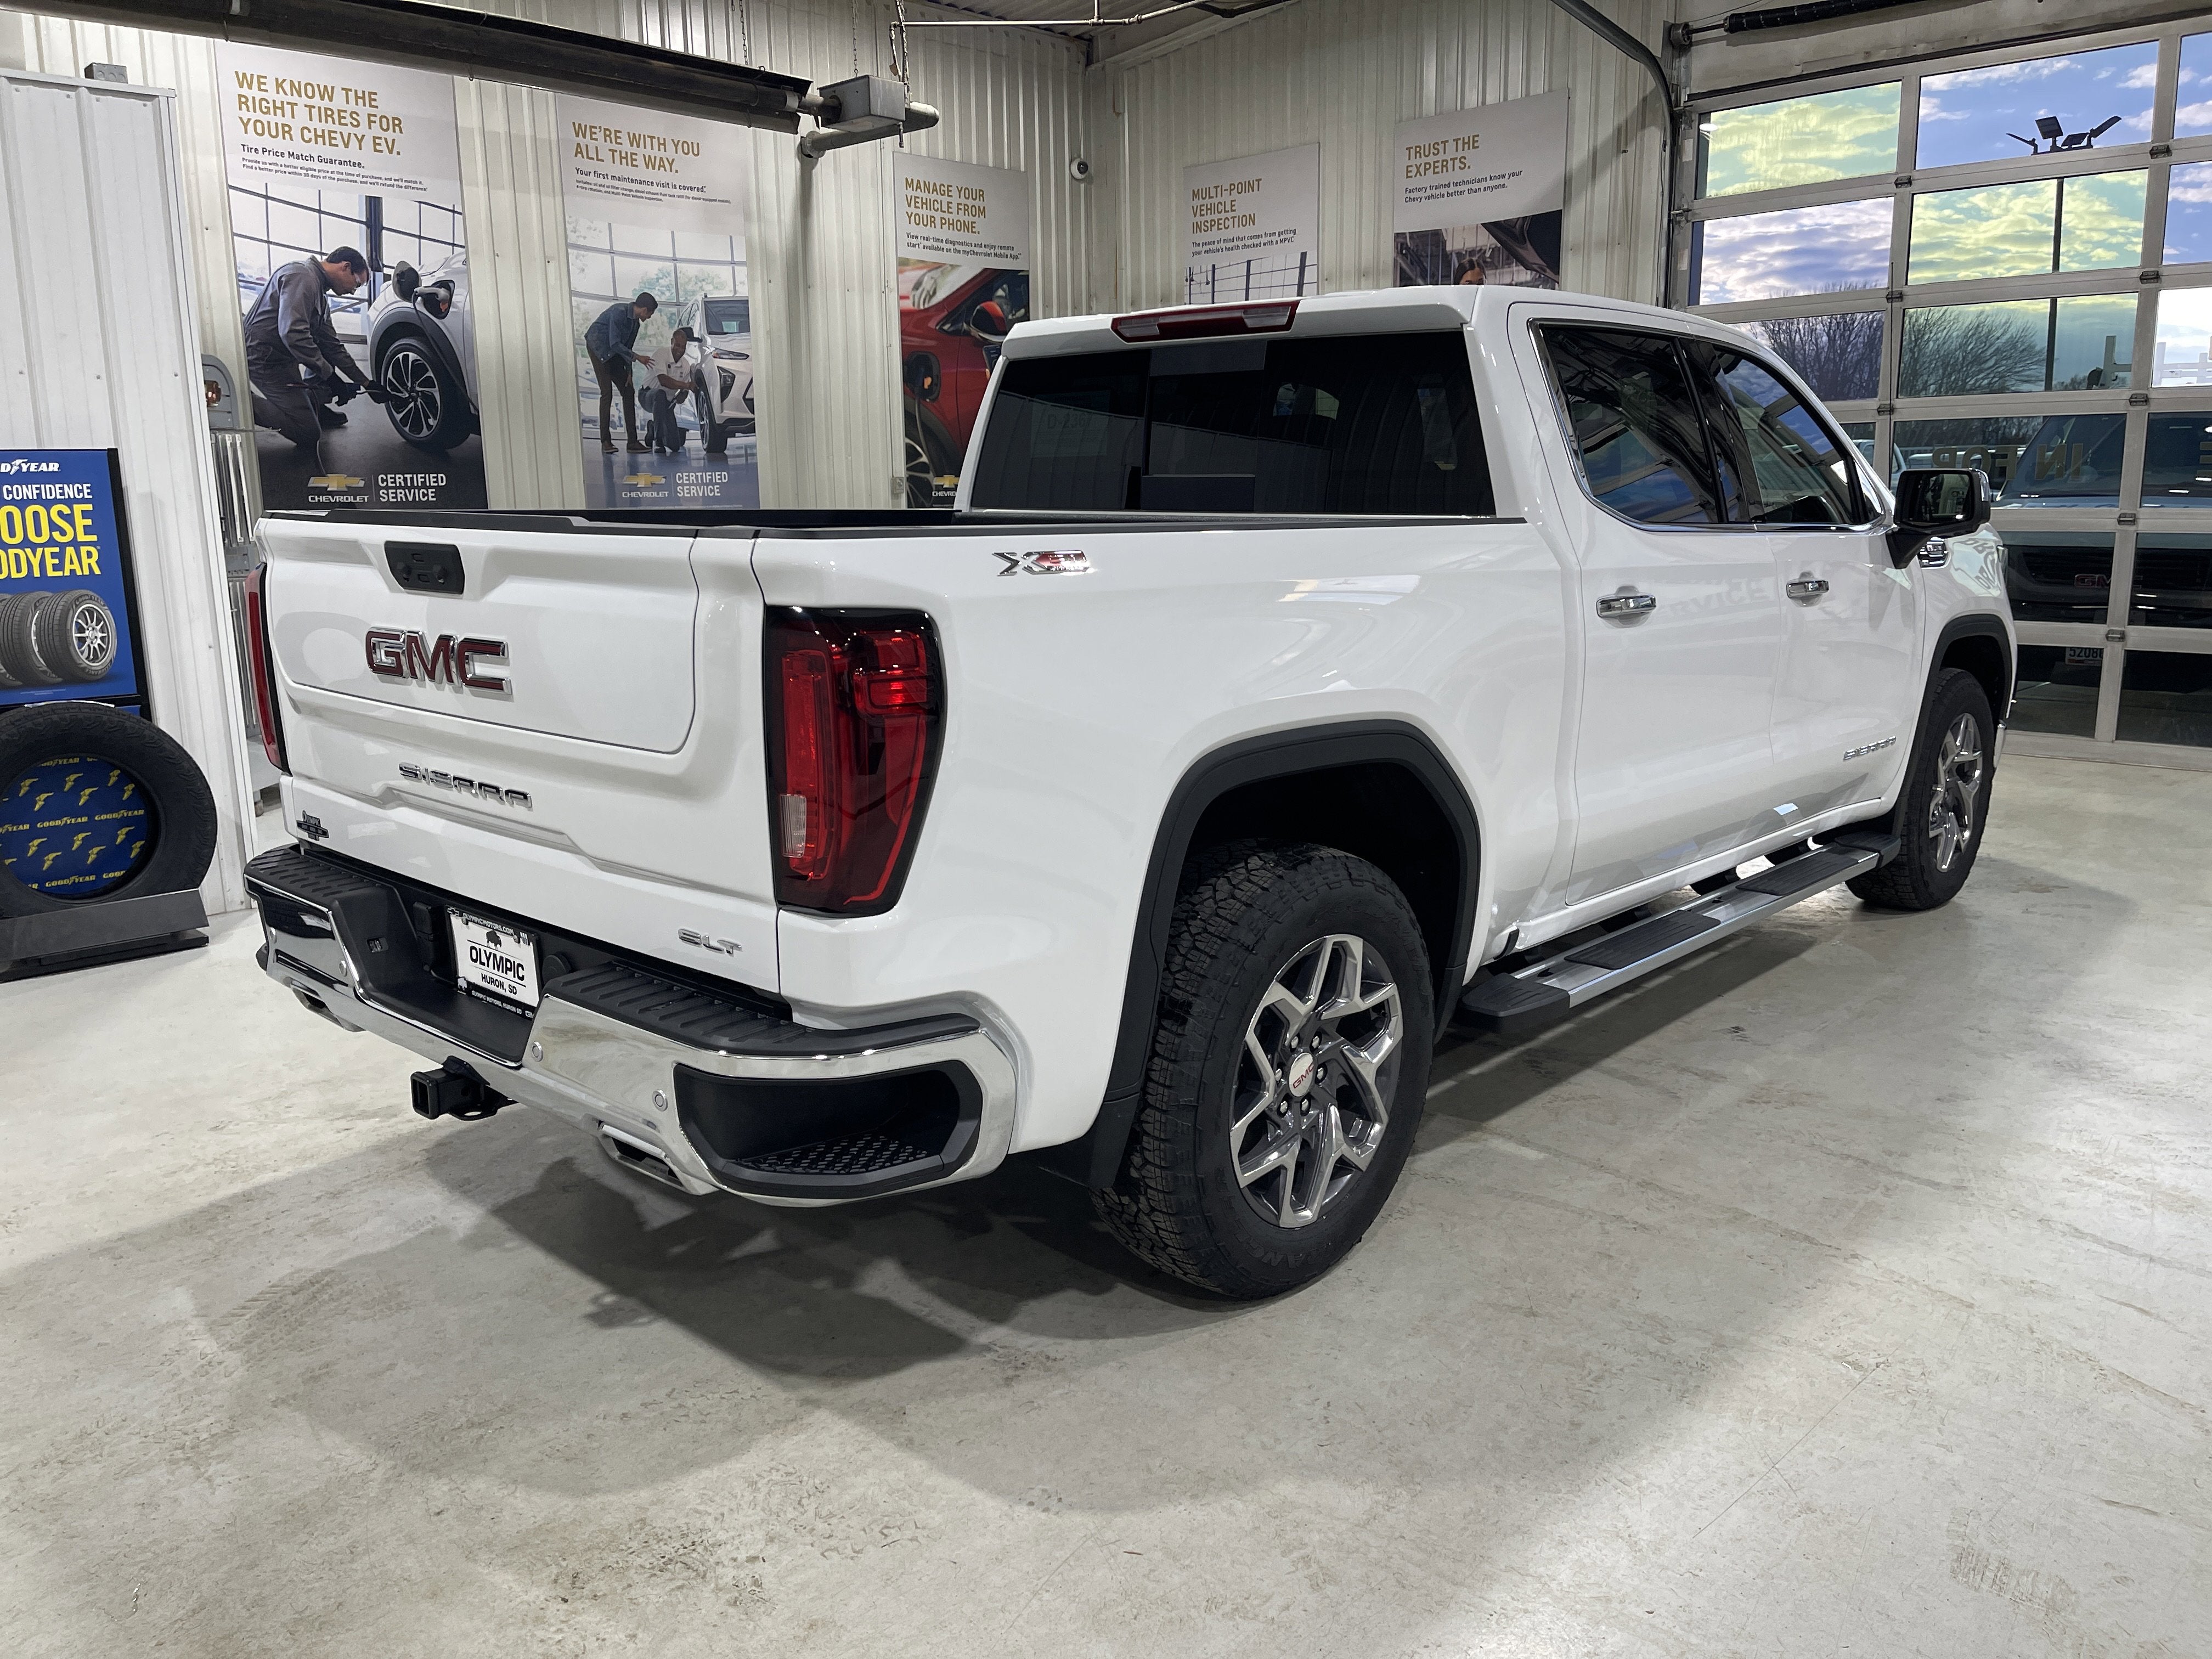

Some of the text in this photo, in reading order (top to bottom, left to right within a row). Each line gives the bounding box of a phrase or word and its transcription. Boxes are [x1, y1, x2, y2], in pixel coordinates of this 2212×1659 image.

[235, 70, 377, 109] WE KNOW THE
[238, 94, 403, 134] RIGHT TIRES FOR
[239, 116, 401, 156] YOUR CHEVY EV.
[573, 121, 699, 156] WE'RE WITH YOU
[1406, 134, 1479, 160] TRUST THE
[240, 144, 364, 168] Tire Price Match Guarantee.
[574, 143, 678, 173] ALL THE WAY.
[575, 167, 591, 176] Your
[593, 170, 608, 179] first
[611, 174, 654, 186] maintenance
[1406, 156, 1471, 179] EXPERTS.
[905, 177, 984, 202] MANAGE YOUR
[1192, 178, 1262, 201] MULTI-POINT
[1429, 181, 1451, 190] trained
[1452, 177, 1487, 187] technicians
[1508, 170, 1522, 179] your
[906, 195, 985, 218] VEHICLE FROM
[1424, 191, 1444, 200] vehicle
[1192, 199, 1237, 218] VEHICLE
[906, 212, 980, 234] YOUR PHONE.
[1192, 213, 1256, 234] INSPECTION
[1277, 229, 1296, 237] getting
[919, 235, 944, 243] real-time
[945, 238, 972, 247] diagnostics
[1241, 241, 1261, 249] checked
[993, 250, 1008, 258] Mobile
[377, 473, 447, 487] CERTIFIED
[676, 471, 728, 483] CERTIFIED
[3, 483, 93, 500] CONFIDENCE
[379, 489, 436, 502] SERVICE
[676, 485, 721, 497] SERVICE
[365, 627, 513, 696] GMC
[399, 762, 533, 811] SIERRA
[37, 816, 88, 828] GOODYEAR
[95, 809, 144, 821] GOODYEAR
[46, 875, 95, 888] GOODYEAR
[678, 928, 742, 956] SLT
[470, 945, 524, 981] OLYMPIC
[481, 973, 517, 995] HURON, SD
[1293, 1061, 1315, 1089] GMC
